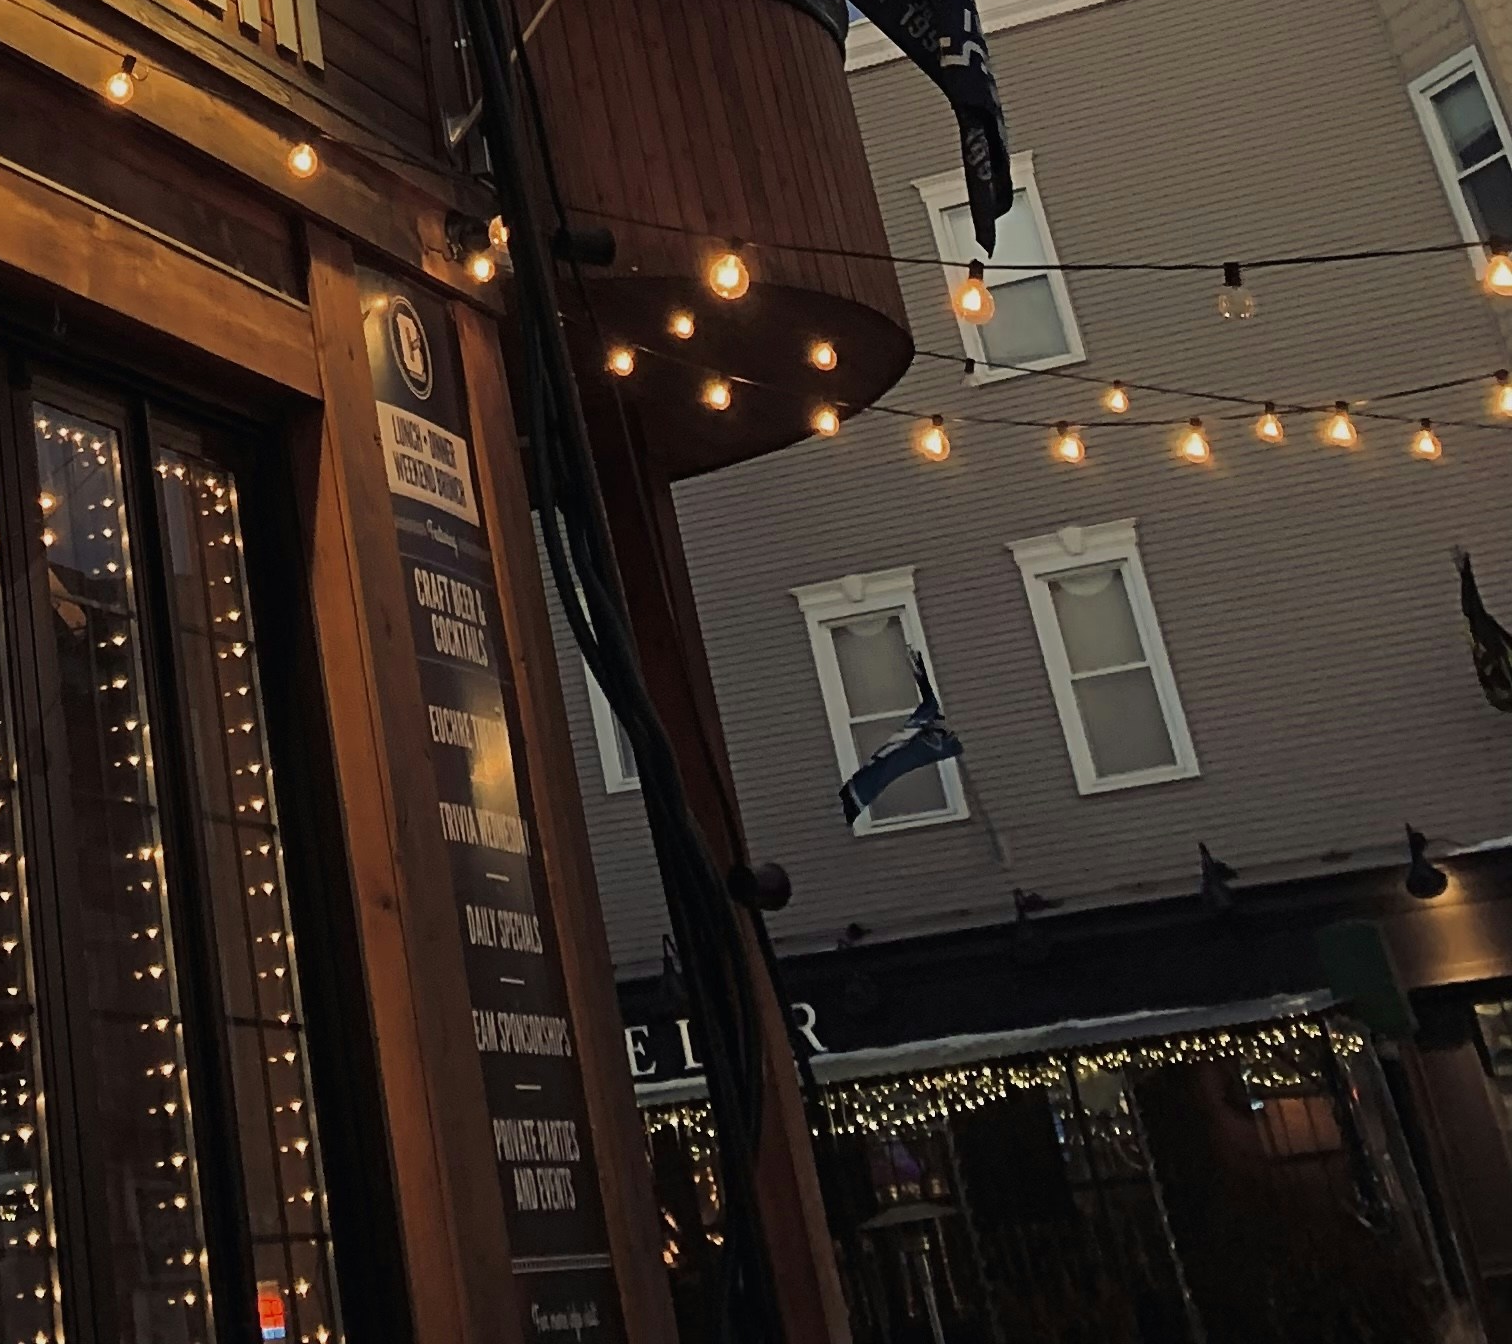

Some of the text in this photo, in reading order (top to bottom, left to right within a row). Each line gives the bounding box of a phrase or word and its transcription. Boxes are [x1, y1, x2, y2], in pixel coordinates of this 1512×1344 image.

[414, 567, 451, 614] CRAFT
[450, 578, 477, 623] BEER
[431, 613, 489, 667] COCKTAILS
[429, 705, 472, 749] EUCHRE
[439, 801, 479, 845] TRIVIA
[466, 904, 543, 955] DAILY SPECIALS
[493, 1119, 581, 1161] PRIVATE PARTIES
[514, 1167, 577, 1210] AND EVENTS
